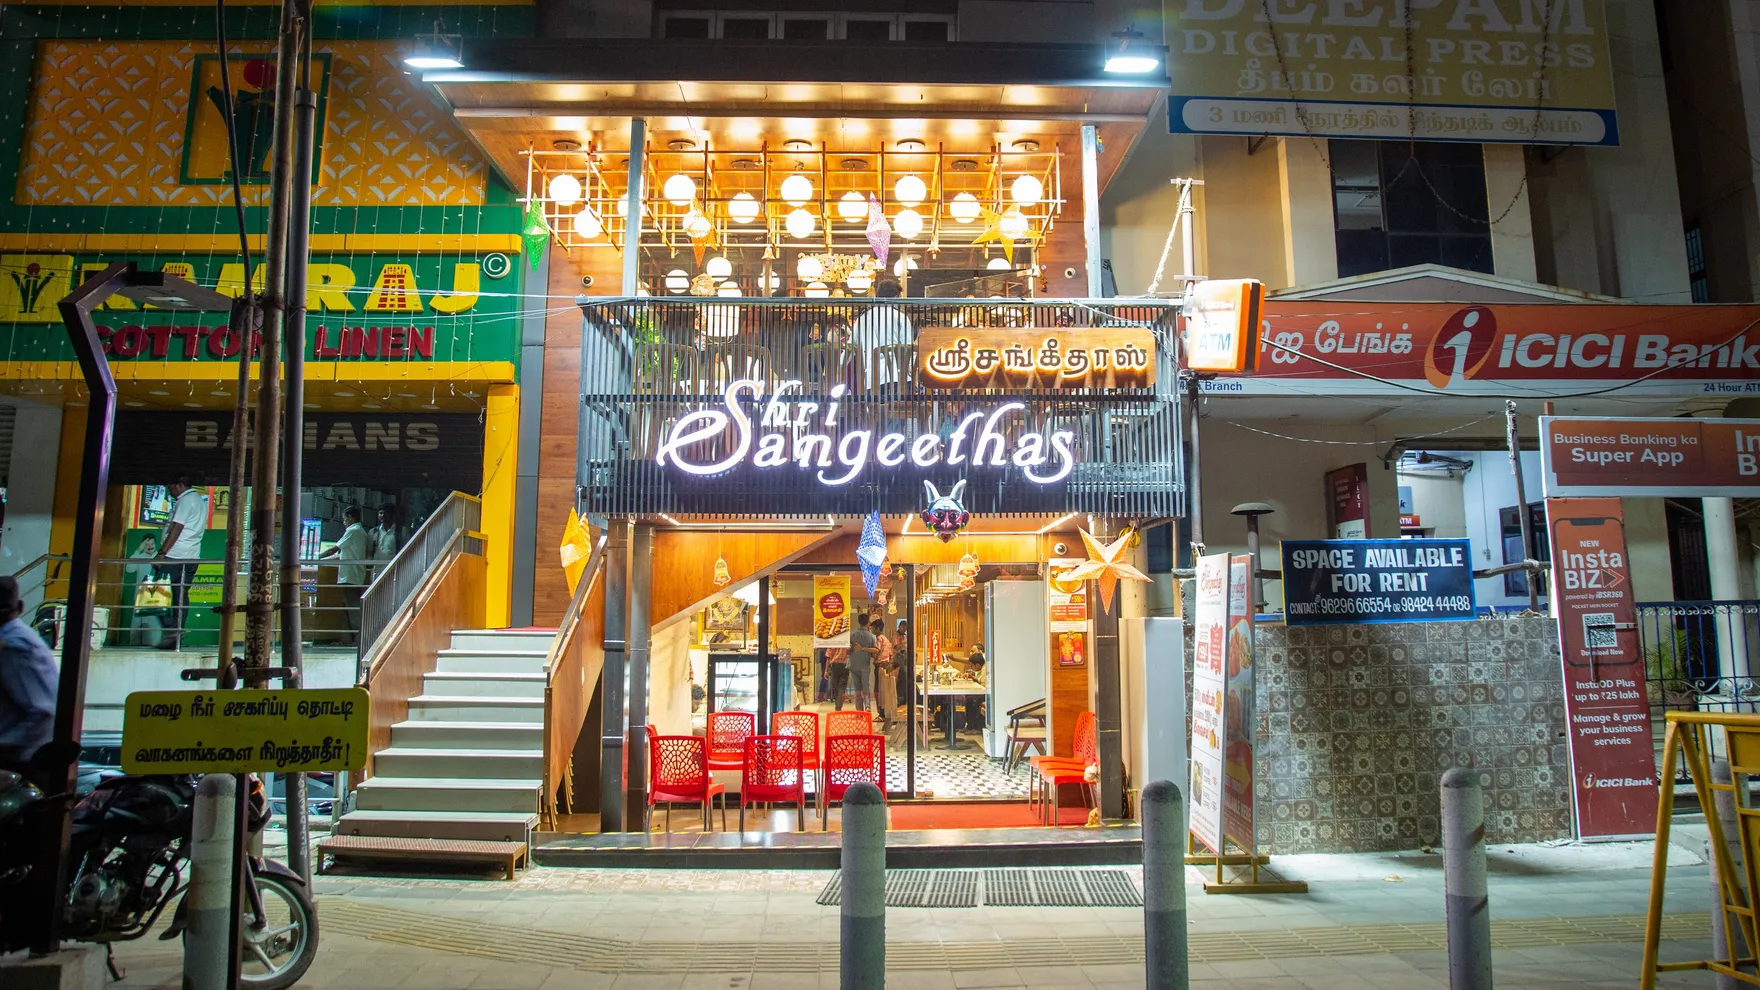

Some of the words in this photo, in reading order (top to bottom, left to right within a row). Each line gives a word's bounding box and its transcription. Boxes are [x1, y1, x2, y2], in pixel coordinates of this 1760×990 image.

[1182, 29, 1406, 61] DIGITAL
[1426, 38, 1595, 68] PRESS
[1236, 58, 1335, 97] தீபம்
[1350, 67, 1447, 96] கலர்
[1209, 106, 1224, 123] 3
[1232, 107, 1287, 125] மணி
[96, 325, 266, 358] COTTO
[315, 326, 434, 358] LINEN
[1199, 333, 1231, 352] ATM
[1314, 321, 1413, 356] பேங்க்
[1498, 333, 1625, 369] ICICI
[1633, 333, 1760, 369] Bank
[1205, 381, 1242, 391] Branch
[1704, 383, 1715, 392] 24
[1718, 383, 1741, 392] Hour
[184, 420, 440, 450] BIANS
[655, 380, 1074, 485] Sangeethas
[1554, 433, 1616, 445] Business
[1620, 434, 1677, 446] Banking
[1681, 435, 1698, 445] ka
[1571, 448, 1634, 466] Super
[1640, 448, 1684, 467] App
[1580, 540, 1600, 548] NEW
[1292, 550, 1355, 569] SPACE
[1365, 547, 1464, 568] AVAILABLE
[1562, 550, 1623, 569] Insta
[1331, 573, 1372, 593] FOR
[1379, 572, 1428, 592] RENT
[1564, 569, 1602, 590] BIZ
[1289, 601, 1320, 615] CONTACT:
[1321, 597, 1355, 614] 96296
[1355, 597, 1392, 613] 66554
[1393, 604, 1401, 612] OR
[1401, 596, 1434, 612] 98424
[1436, 595, 1471, 612] 44488
[1575, 680, 1614, 689] InstaOD
[1616, 680, 1635, 688] Plus
[1575, 693, 1587, 702] up
[1589, 692, 1599, 700] to
[1619, 691, 1639, 699] lakh
[139, 702, 182, 721] மழை
[190, 694, 216, 717] நீர்
[223, 696, 288, 721] சேகரிப்பு
[297, 699, 354, 722] தொட்டி
[1573, 714, 1611, 725] Manage
[1613, 713, 1622, 722] &
[1624, 714, 1646, 724] grow
[1580, 727, 1600, 737] your
[1602, 724, 1643, 733] business
[1594, 737, 1632, 746] services
[135, 740, 254, 763] வாகனங்களை
[1596, 778, 1623, 788] ICICI
[1624, 777, 1653, 787] Bank
